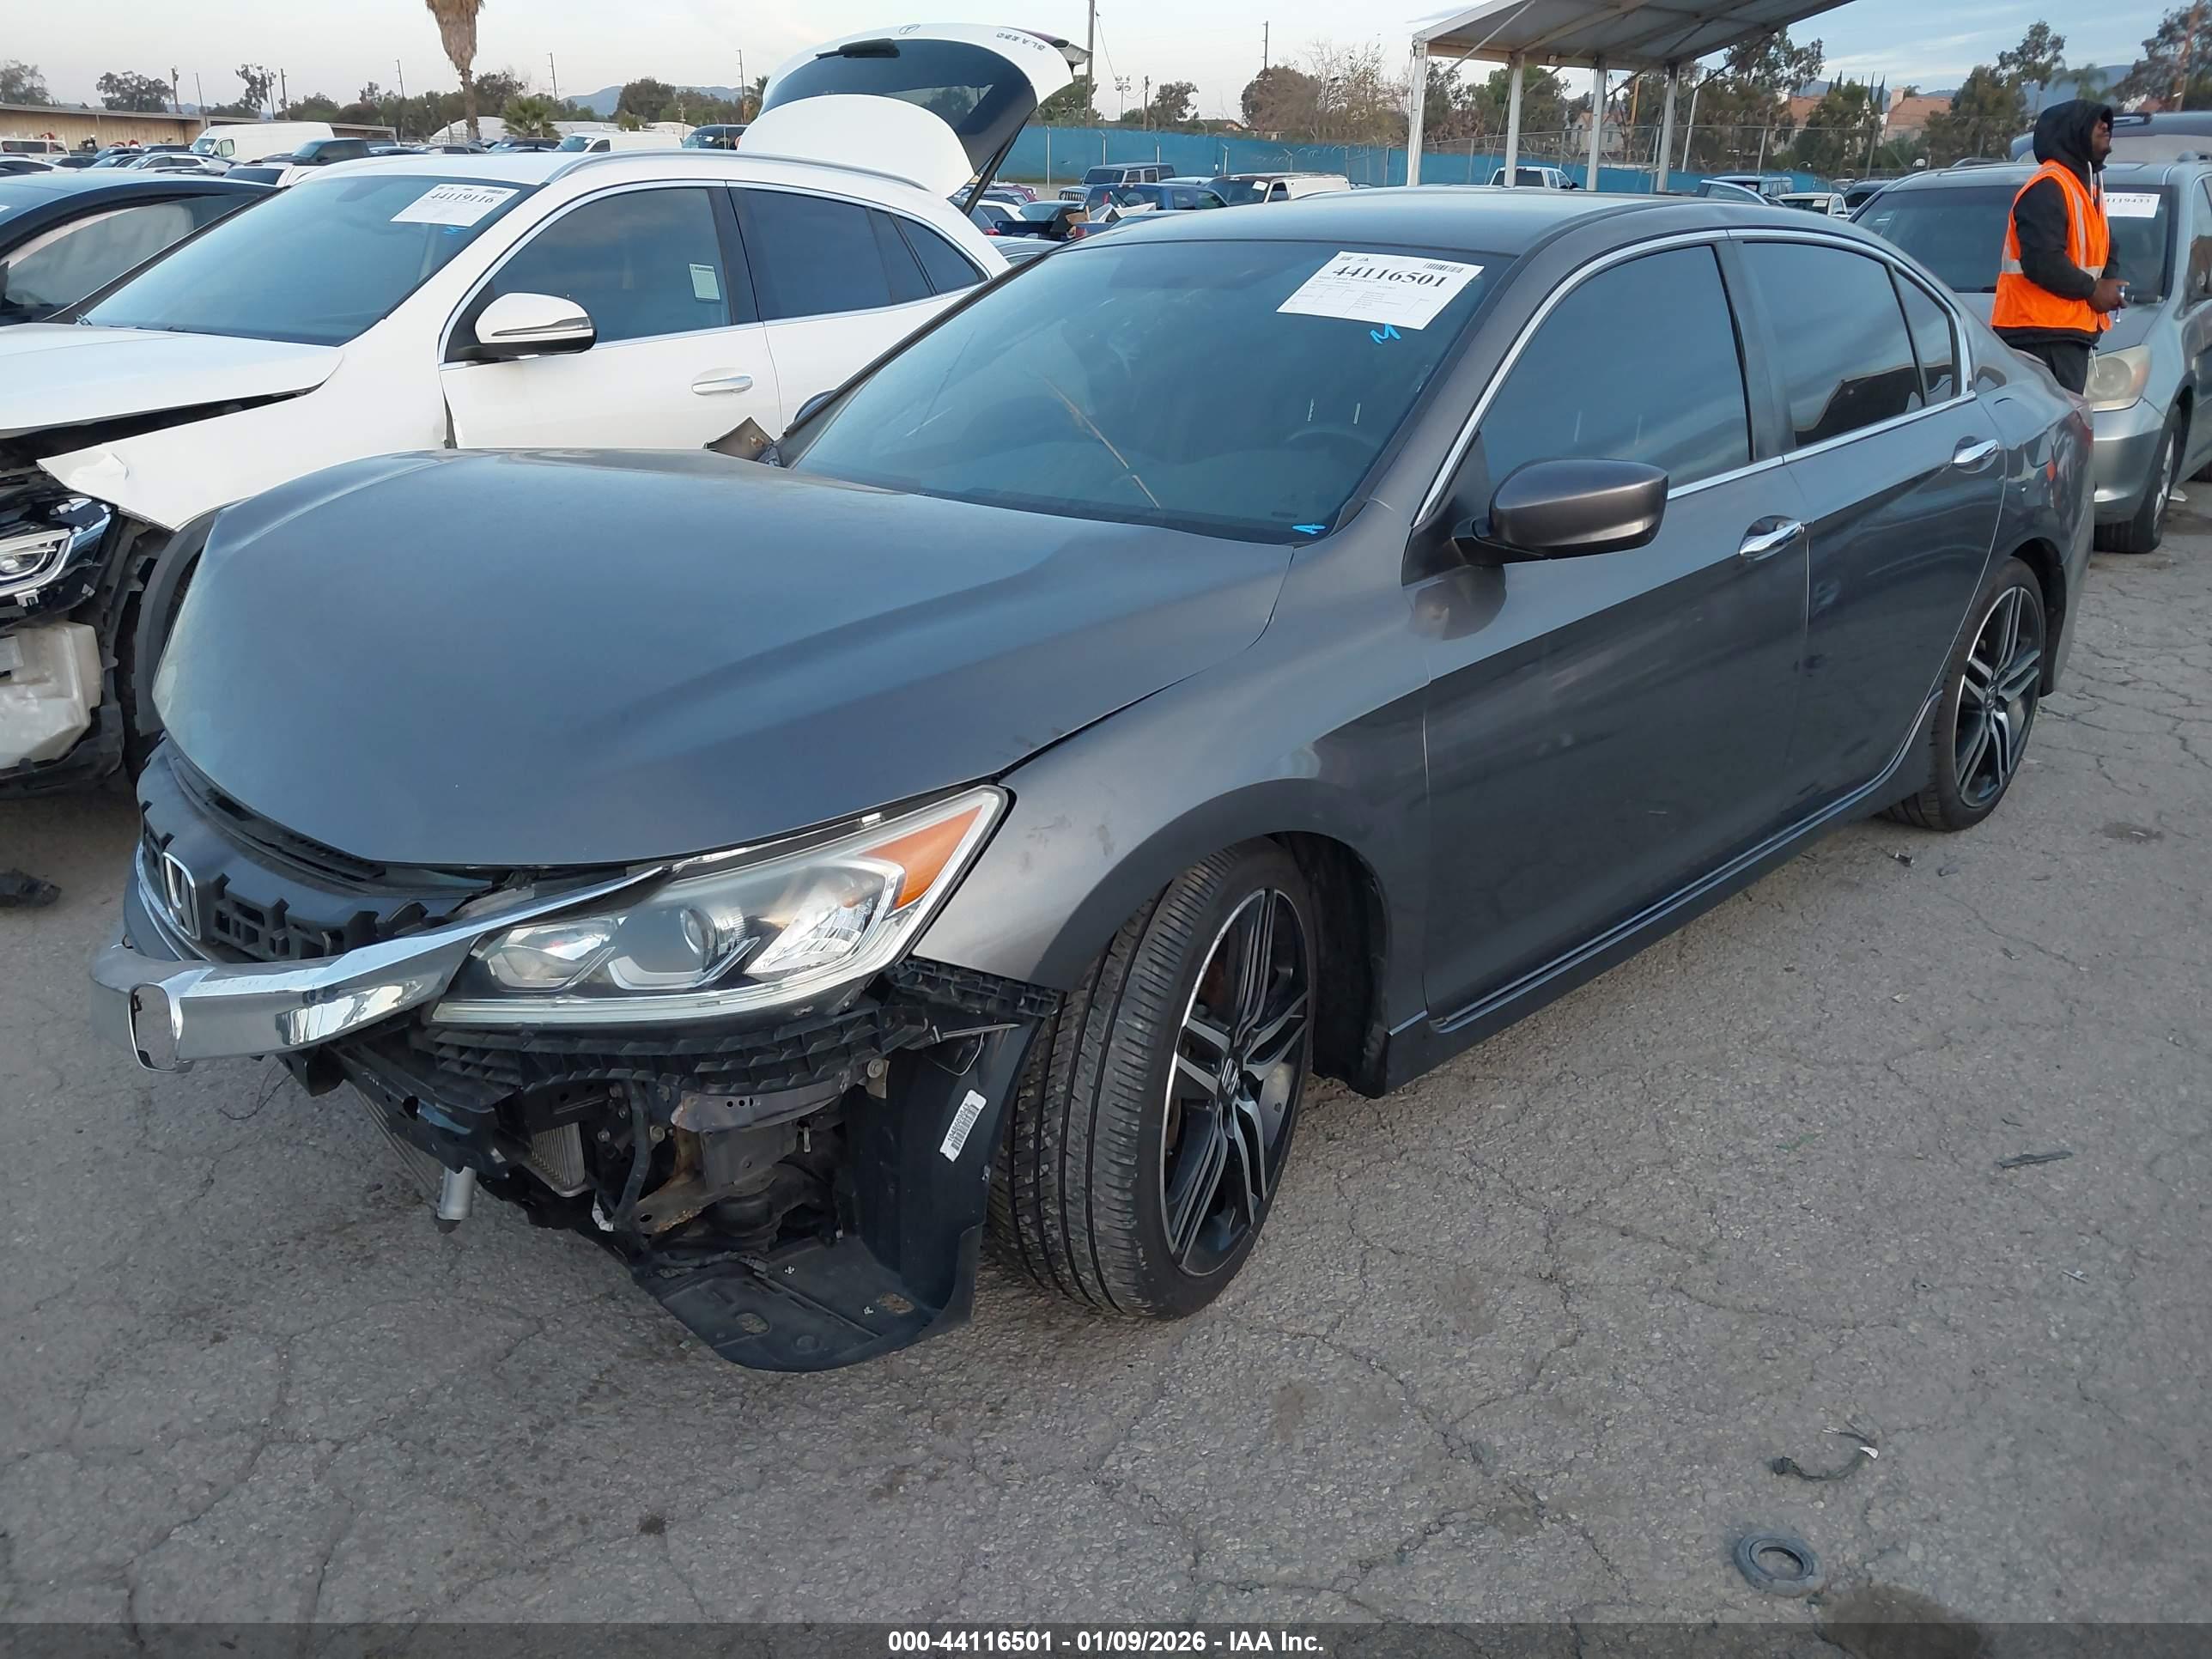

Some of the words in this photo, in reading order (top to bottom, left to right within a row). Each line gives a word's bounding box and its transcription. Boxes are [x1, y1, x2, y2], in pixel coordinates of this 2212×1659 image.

[1022, 38, 1046, 51] GLA
[430, 191, 495, 204] 44119116
[1333, 265, 1447, 288] 44116501
